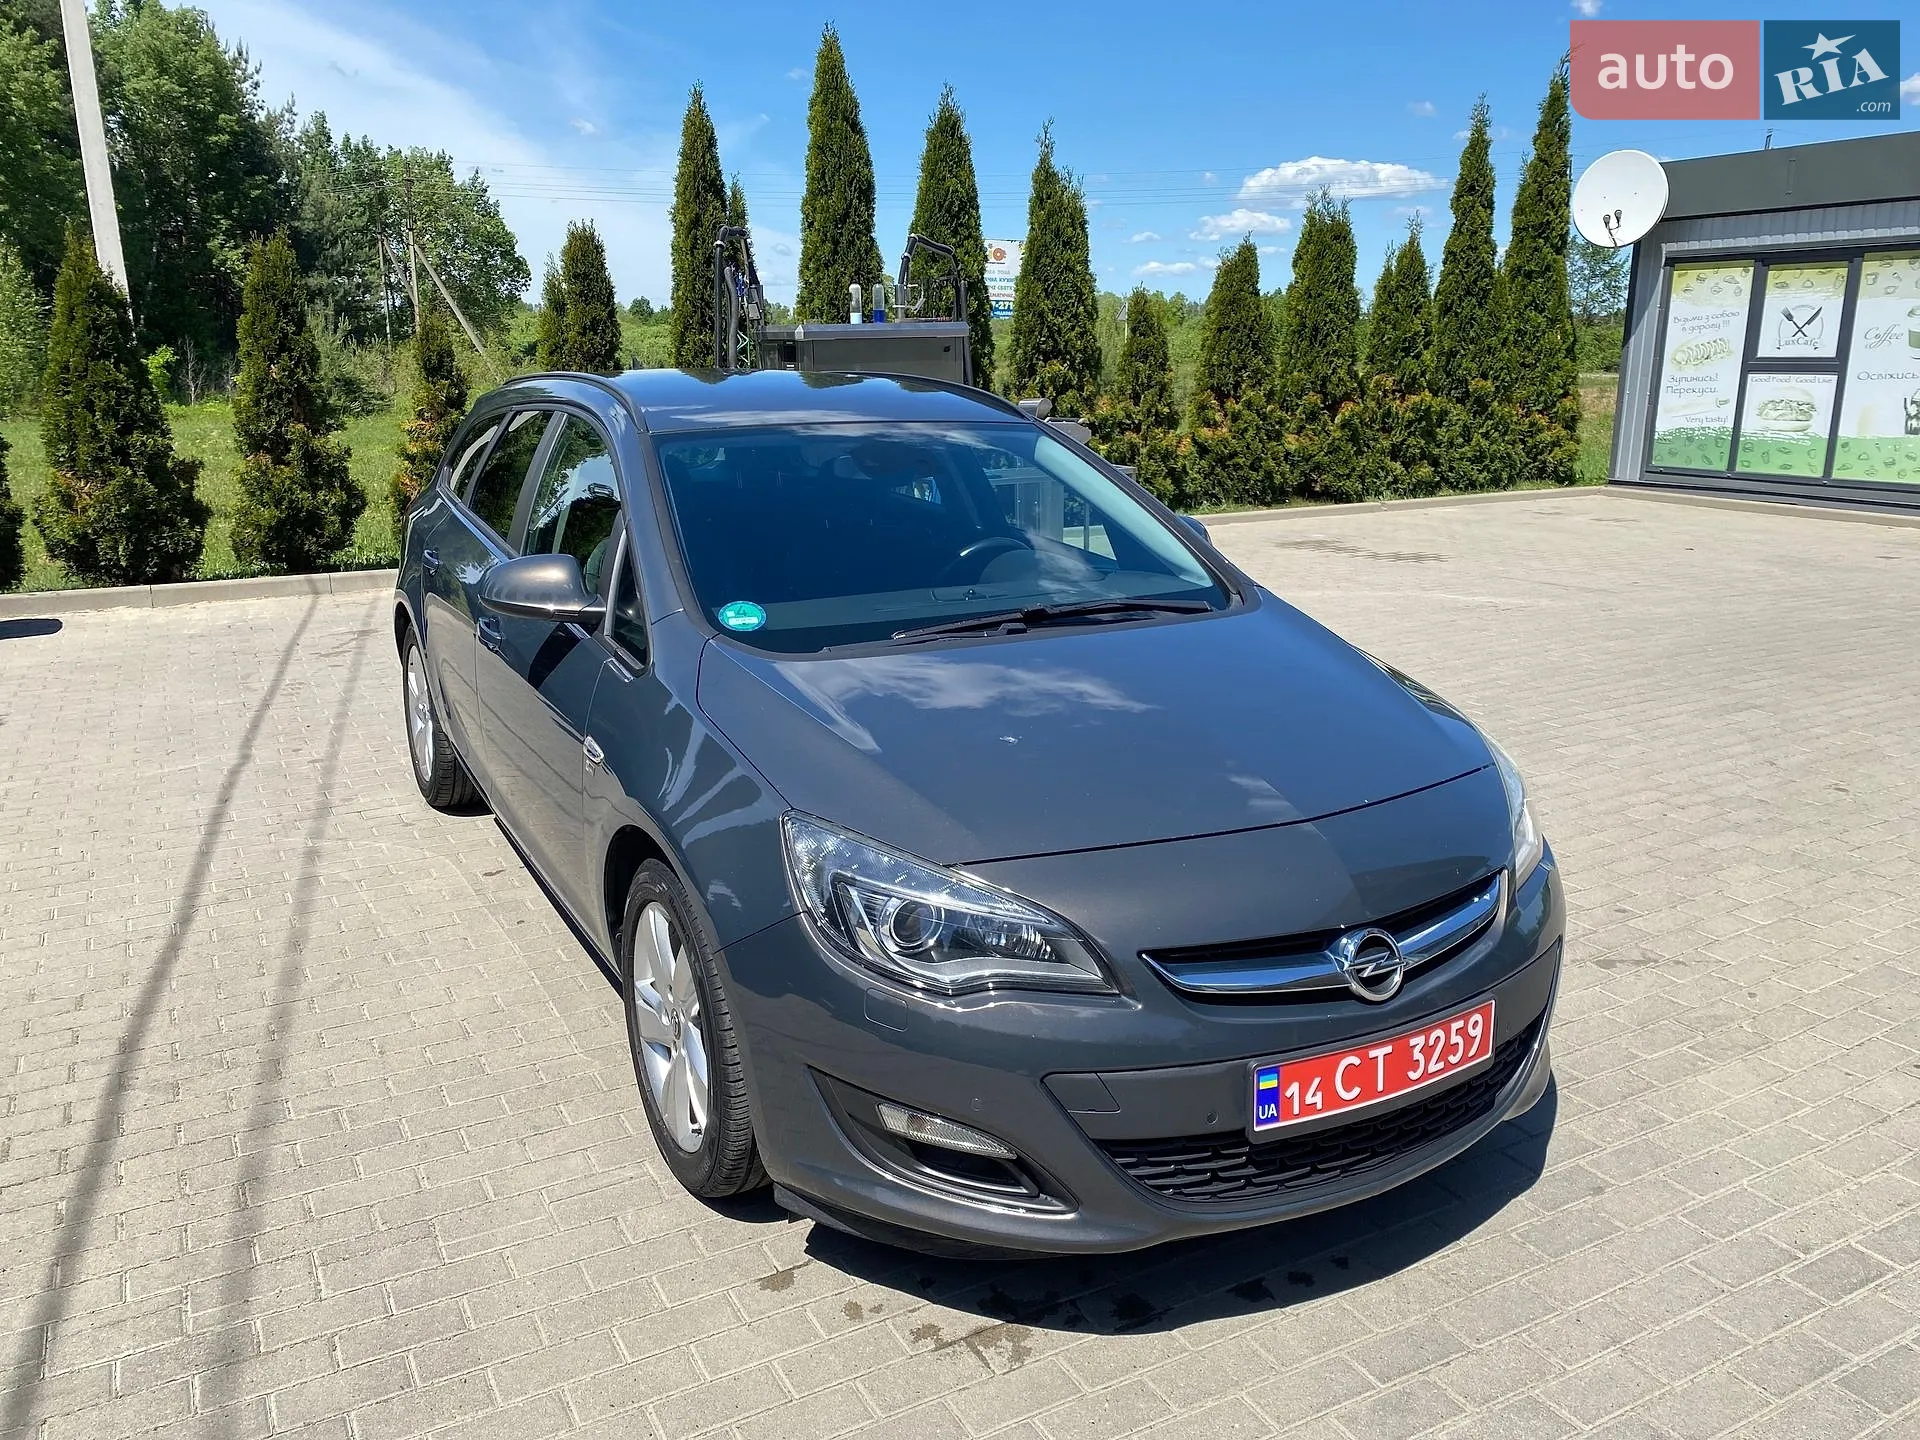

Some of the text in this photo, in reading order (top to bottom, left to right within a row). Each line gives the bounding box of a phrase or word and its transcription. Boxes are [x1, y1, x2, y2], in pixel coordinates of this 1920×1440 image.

[1711, 310, 1740, 320] собою
[1864, 324, 1904, 349] Coffee
[1684, 416, 1704, 425] Very
[1284, 1013, 1483, 1116] 14 CT 3259
[1258, 1103, 1278, 1120] UA
